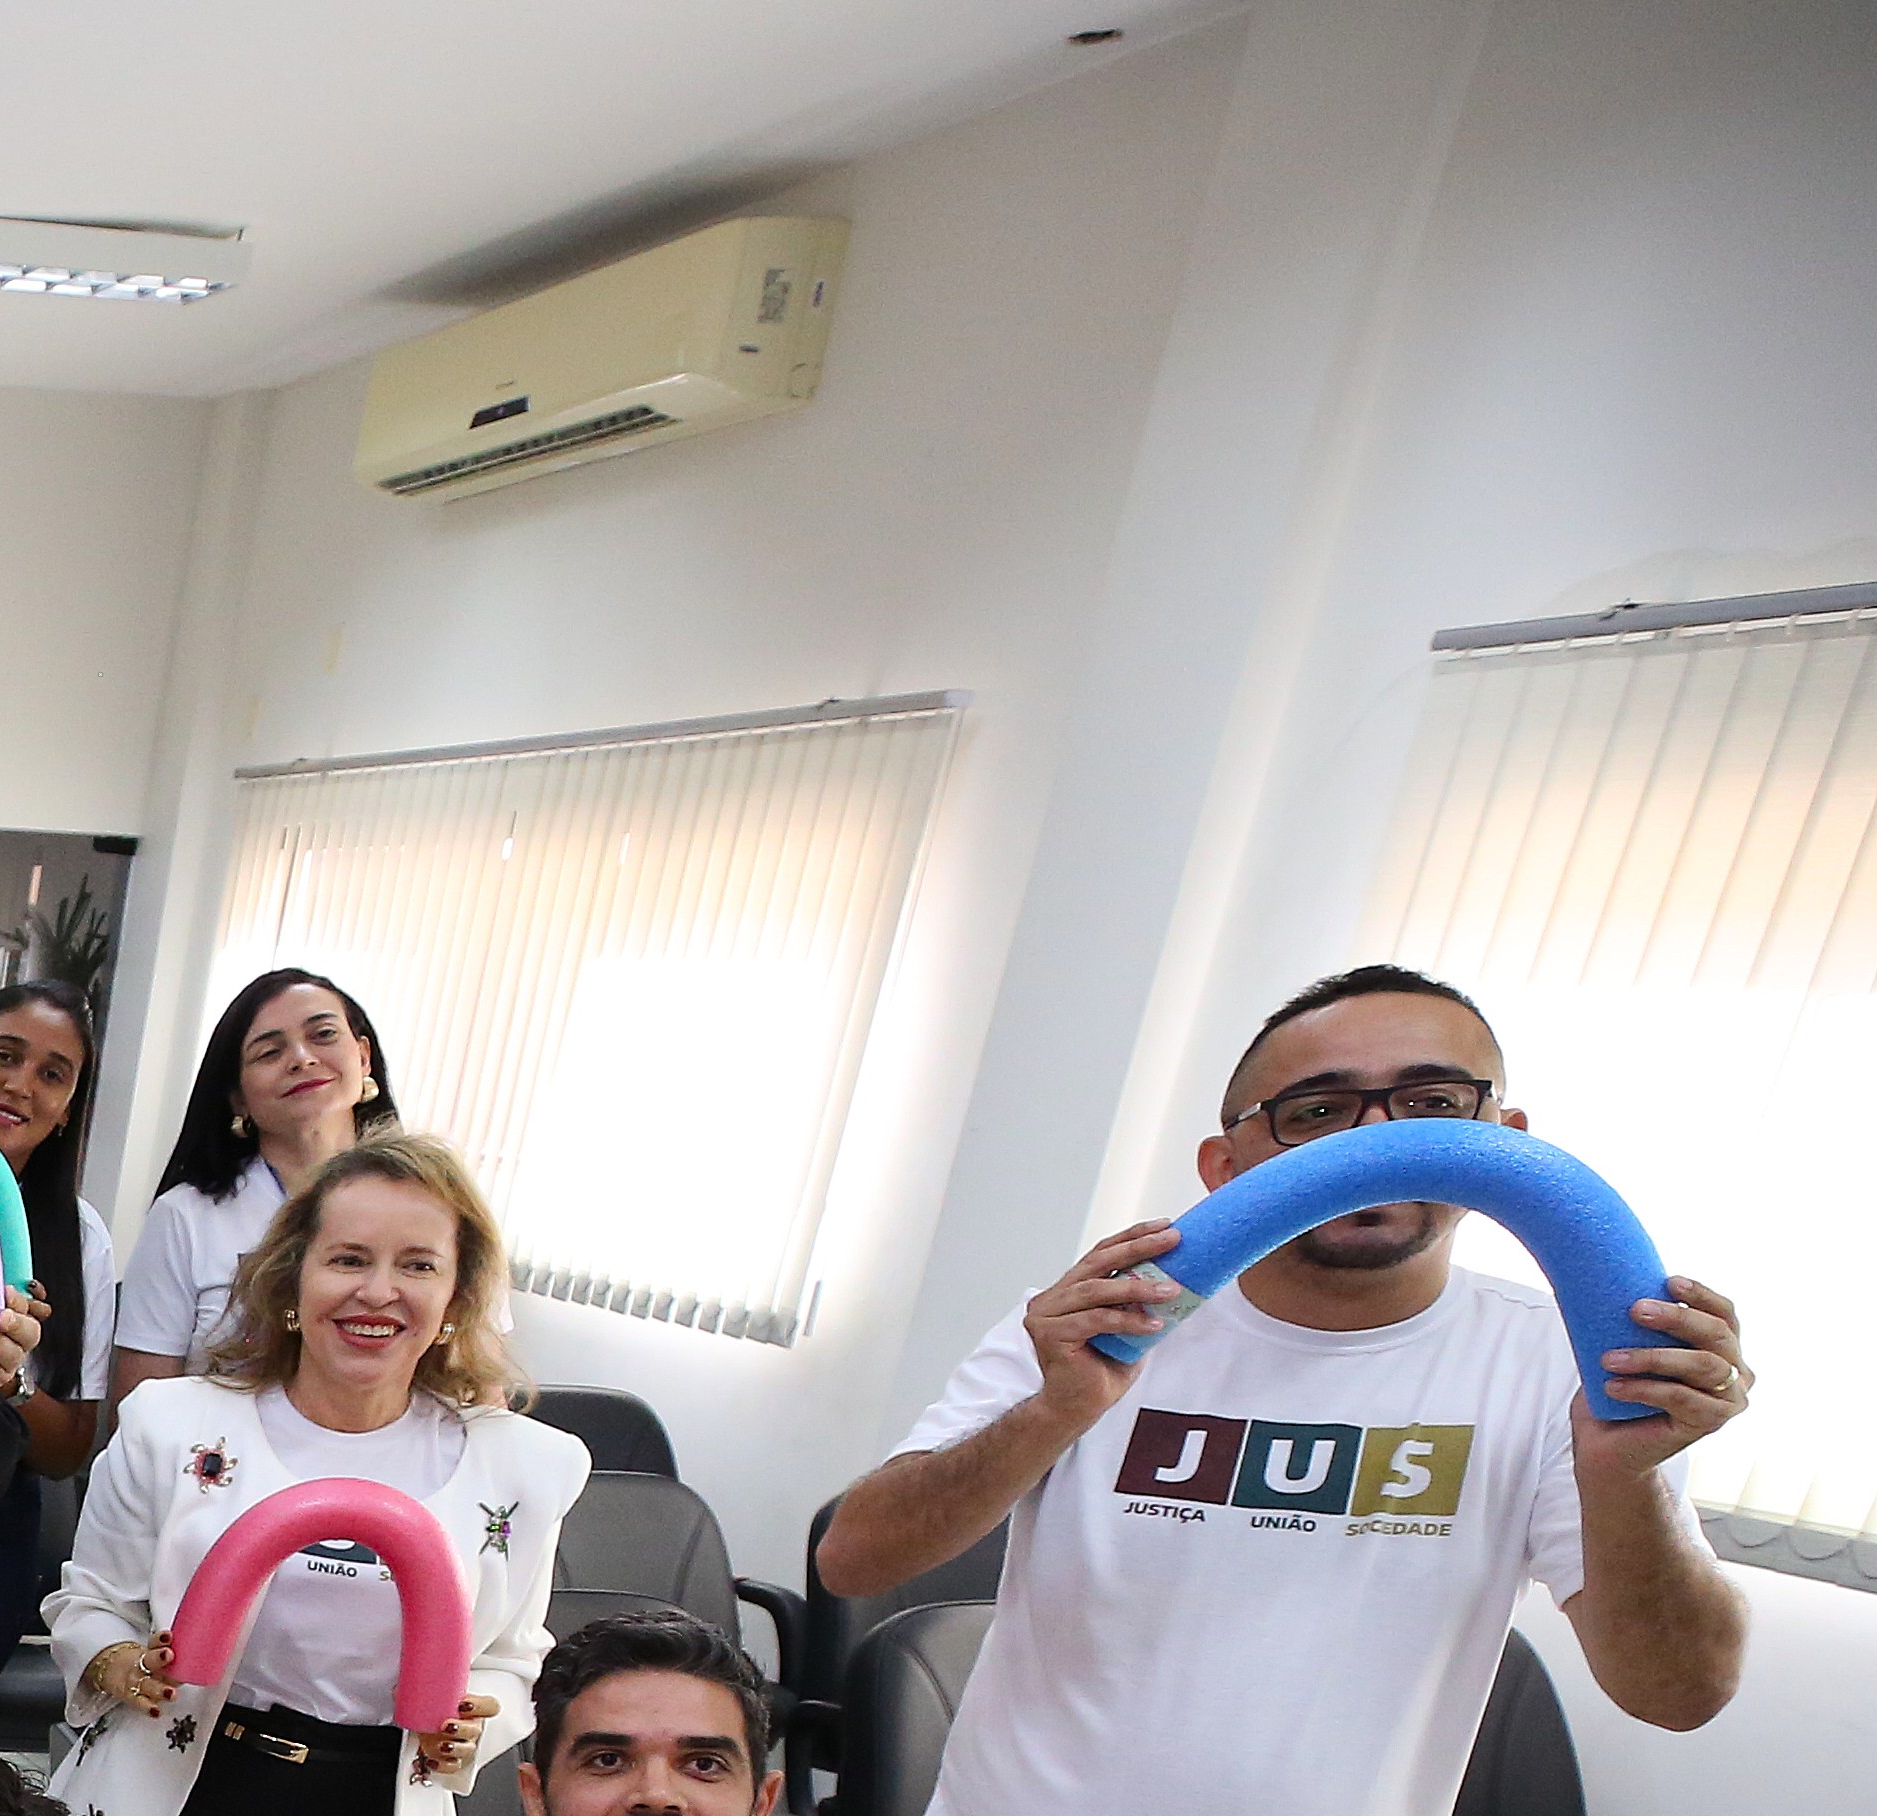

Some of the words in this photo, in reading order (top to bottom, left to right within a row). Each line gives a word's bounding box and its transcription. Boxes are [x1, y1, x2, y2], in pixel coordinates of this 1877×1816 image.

[1154, 1429, 1435, 1499] JUS
[1123, 1501, 1206, 1524] JUSTIÇA
[1250, 1513, 1317, 1533] UNIÃO
[307, 1560, 358, 1578] UNIÃO
